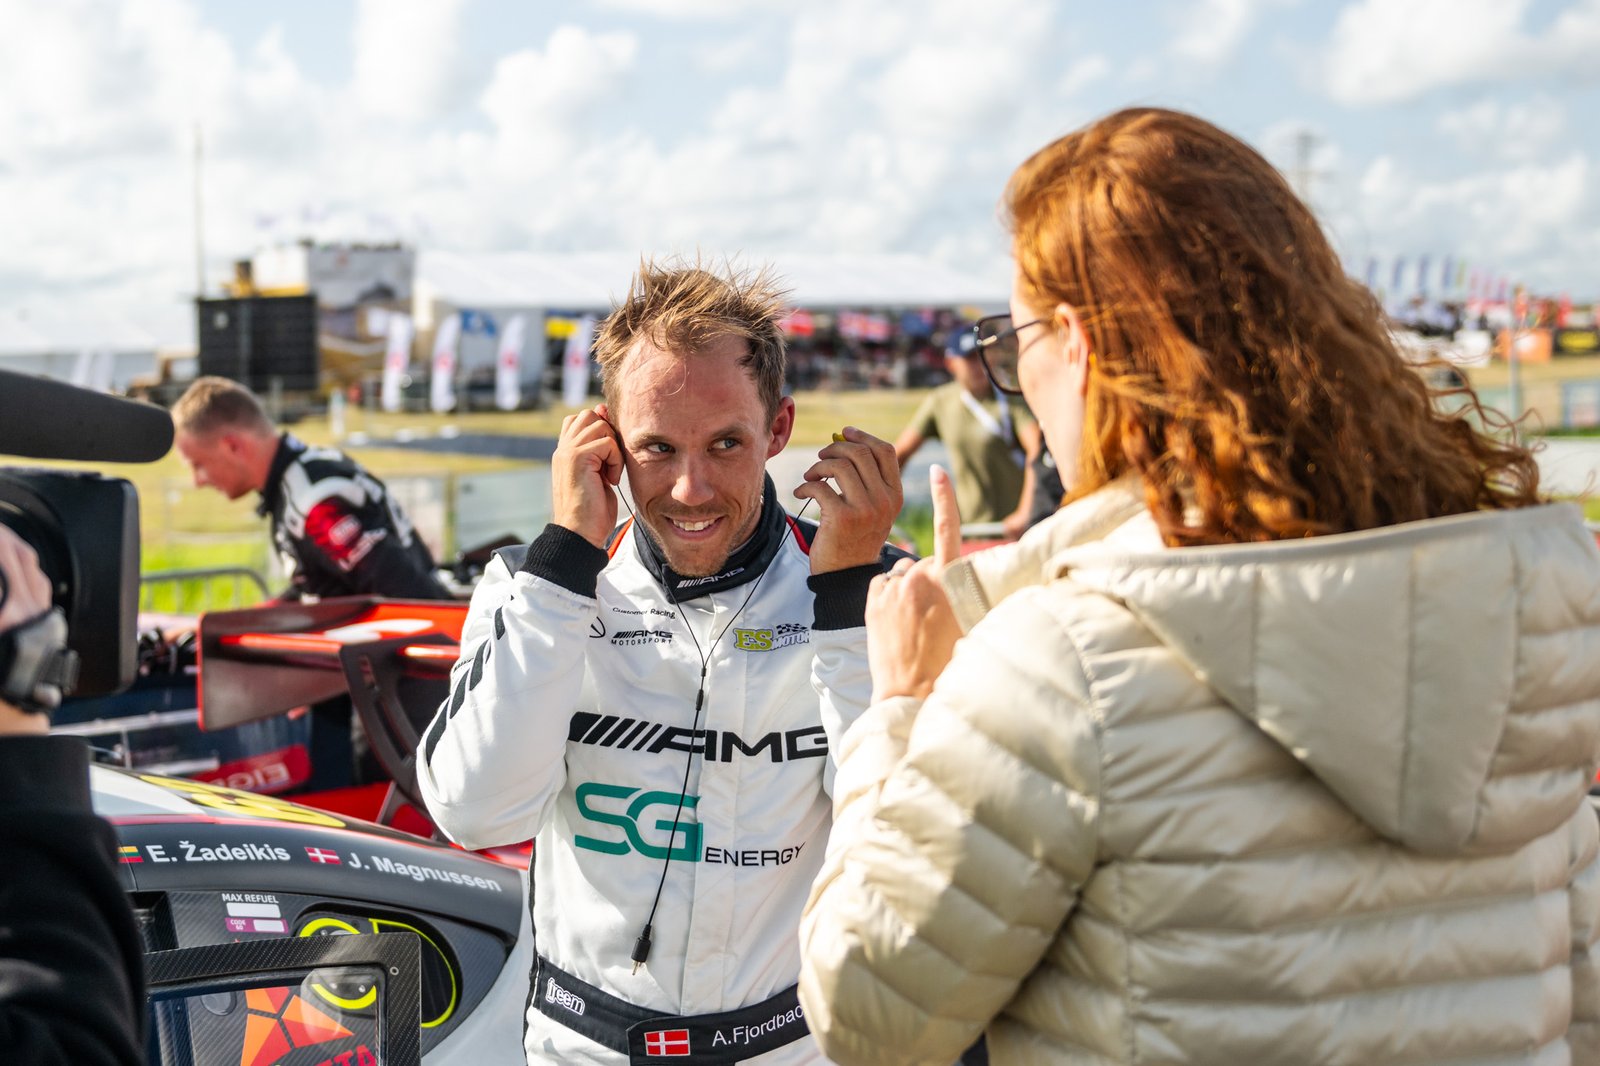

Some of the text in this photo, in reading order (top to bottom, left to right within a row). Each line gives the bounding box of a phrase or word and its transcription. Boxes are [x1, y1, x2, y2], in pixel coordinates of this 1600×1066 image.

[612, 607, 676, 619] Customer Racing
[611, 638, 672, 646] MOTORSPORT
[632, 630, 673, 639] AMG
[733, 628, 774, 652] ES
[646, 725, 829, 763] AMG
[574, 782, 806, 867] SG ENERGY
[145, 840, 292, 863] E. Žadeikis
[348, 852, 502, 892] J. Magnussen
[221, 893, 279, 904] MAX REFUEL
